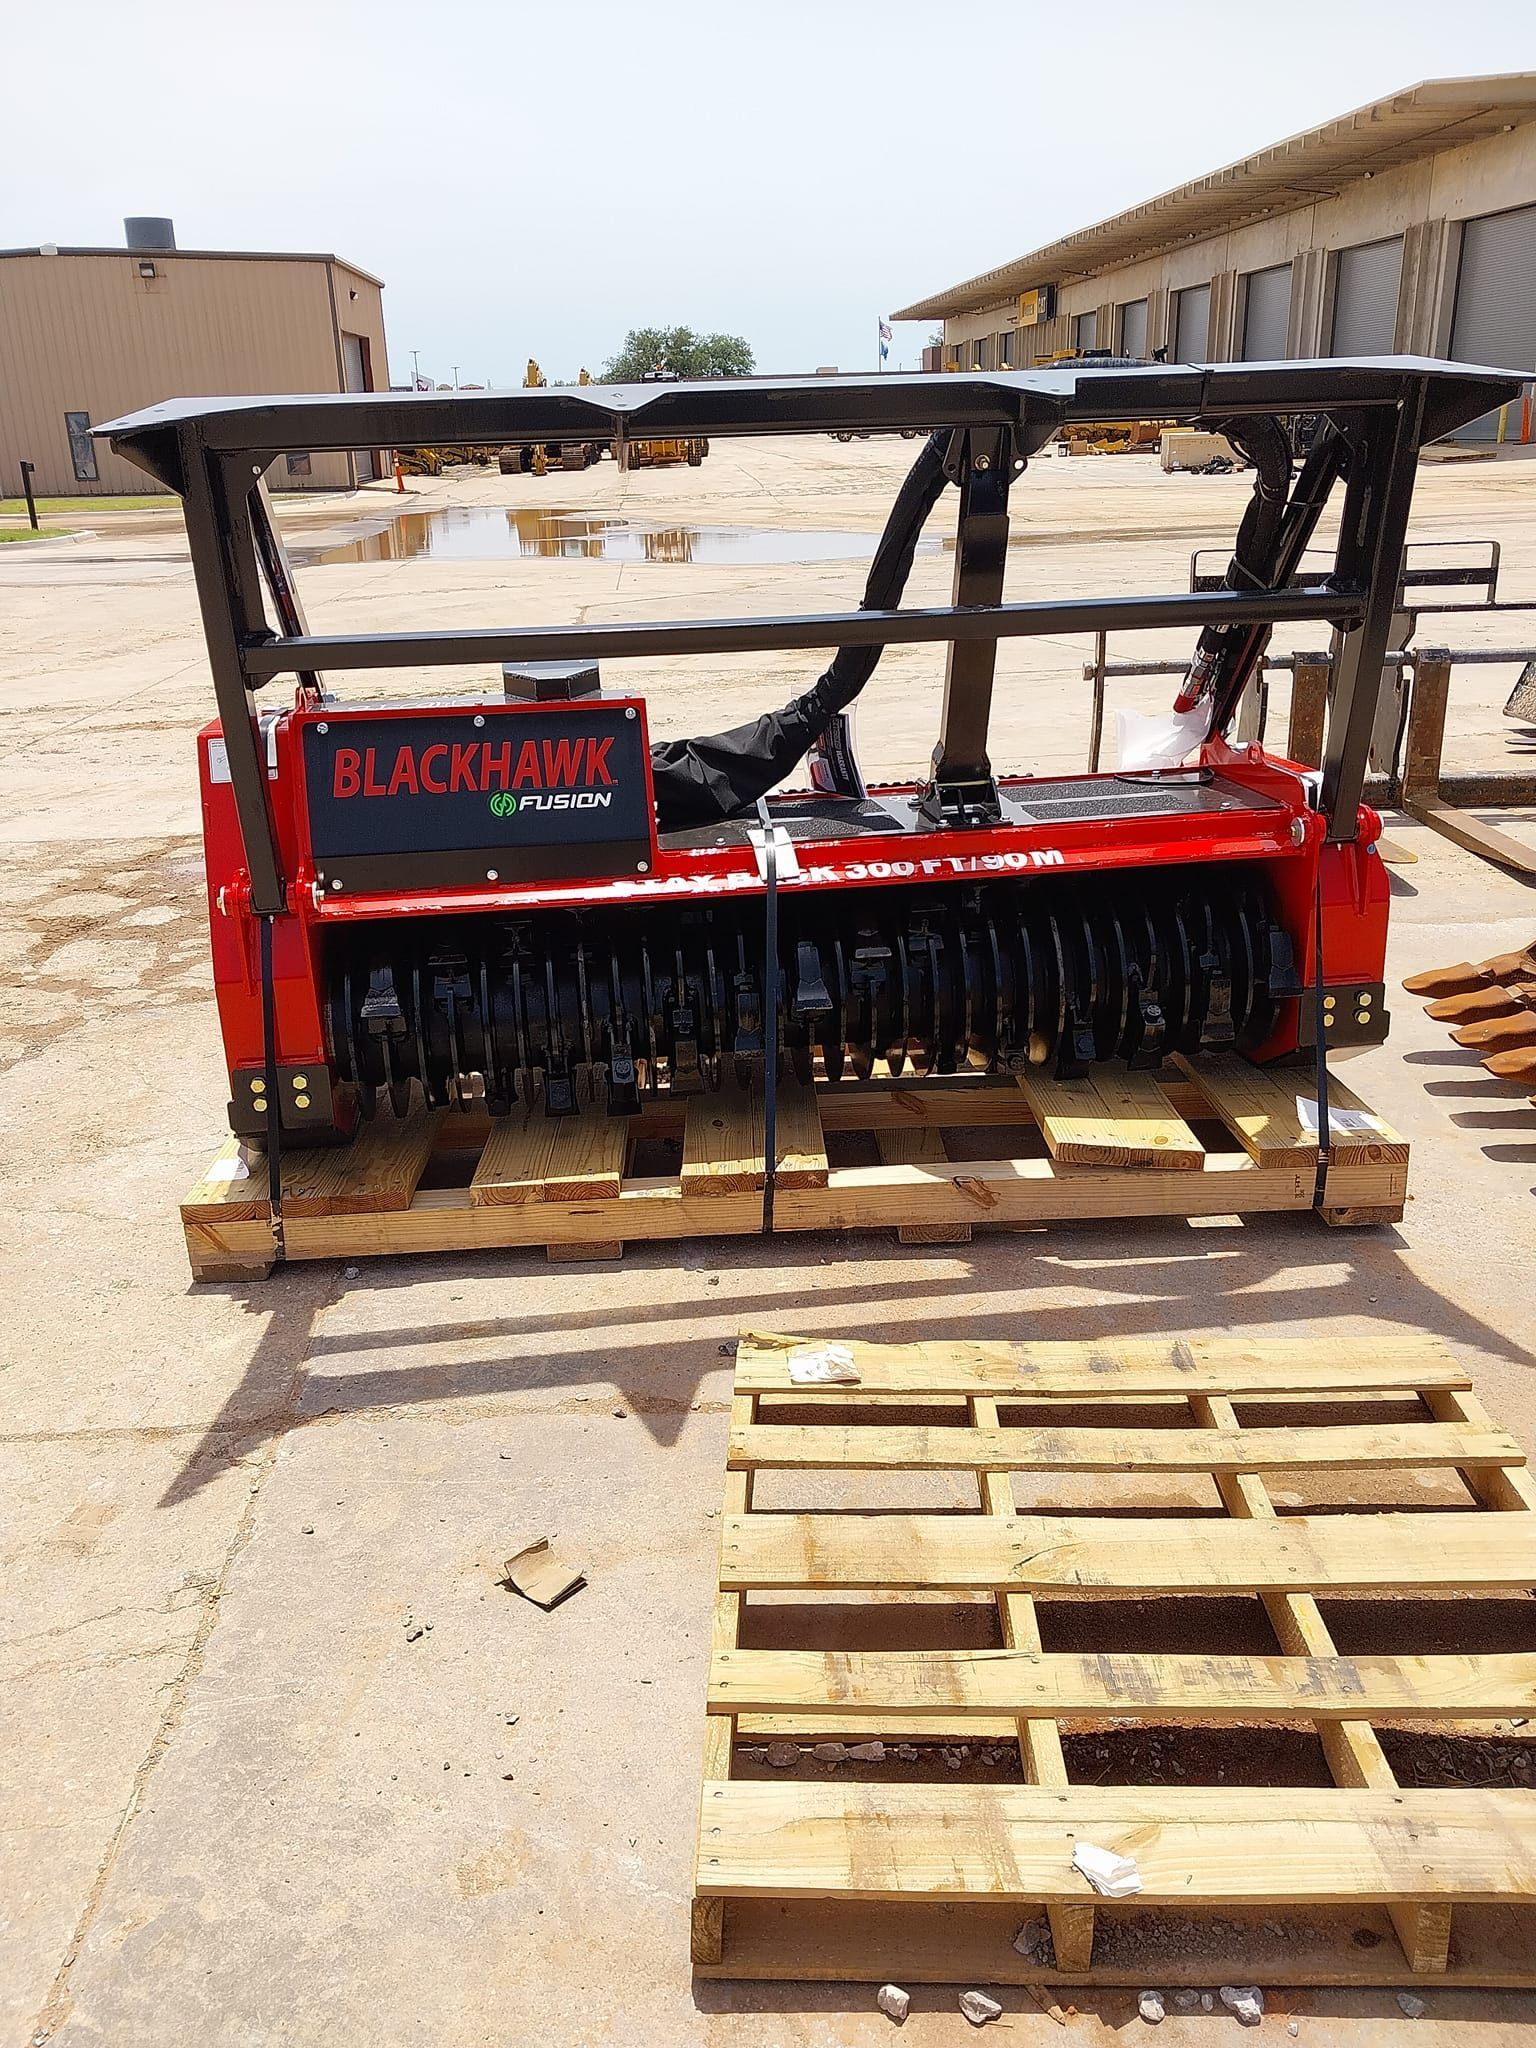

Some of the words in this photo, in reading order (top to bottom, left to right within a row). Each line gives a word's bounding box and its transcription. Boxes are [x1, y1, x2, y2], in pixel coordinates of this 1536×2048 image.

[333, 737, 615, 797] BLACKHAWK
[519, 792, 612, 811] FUSION
[844, 861, 915, 880] 300
